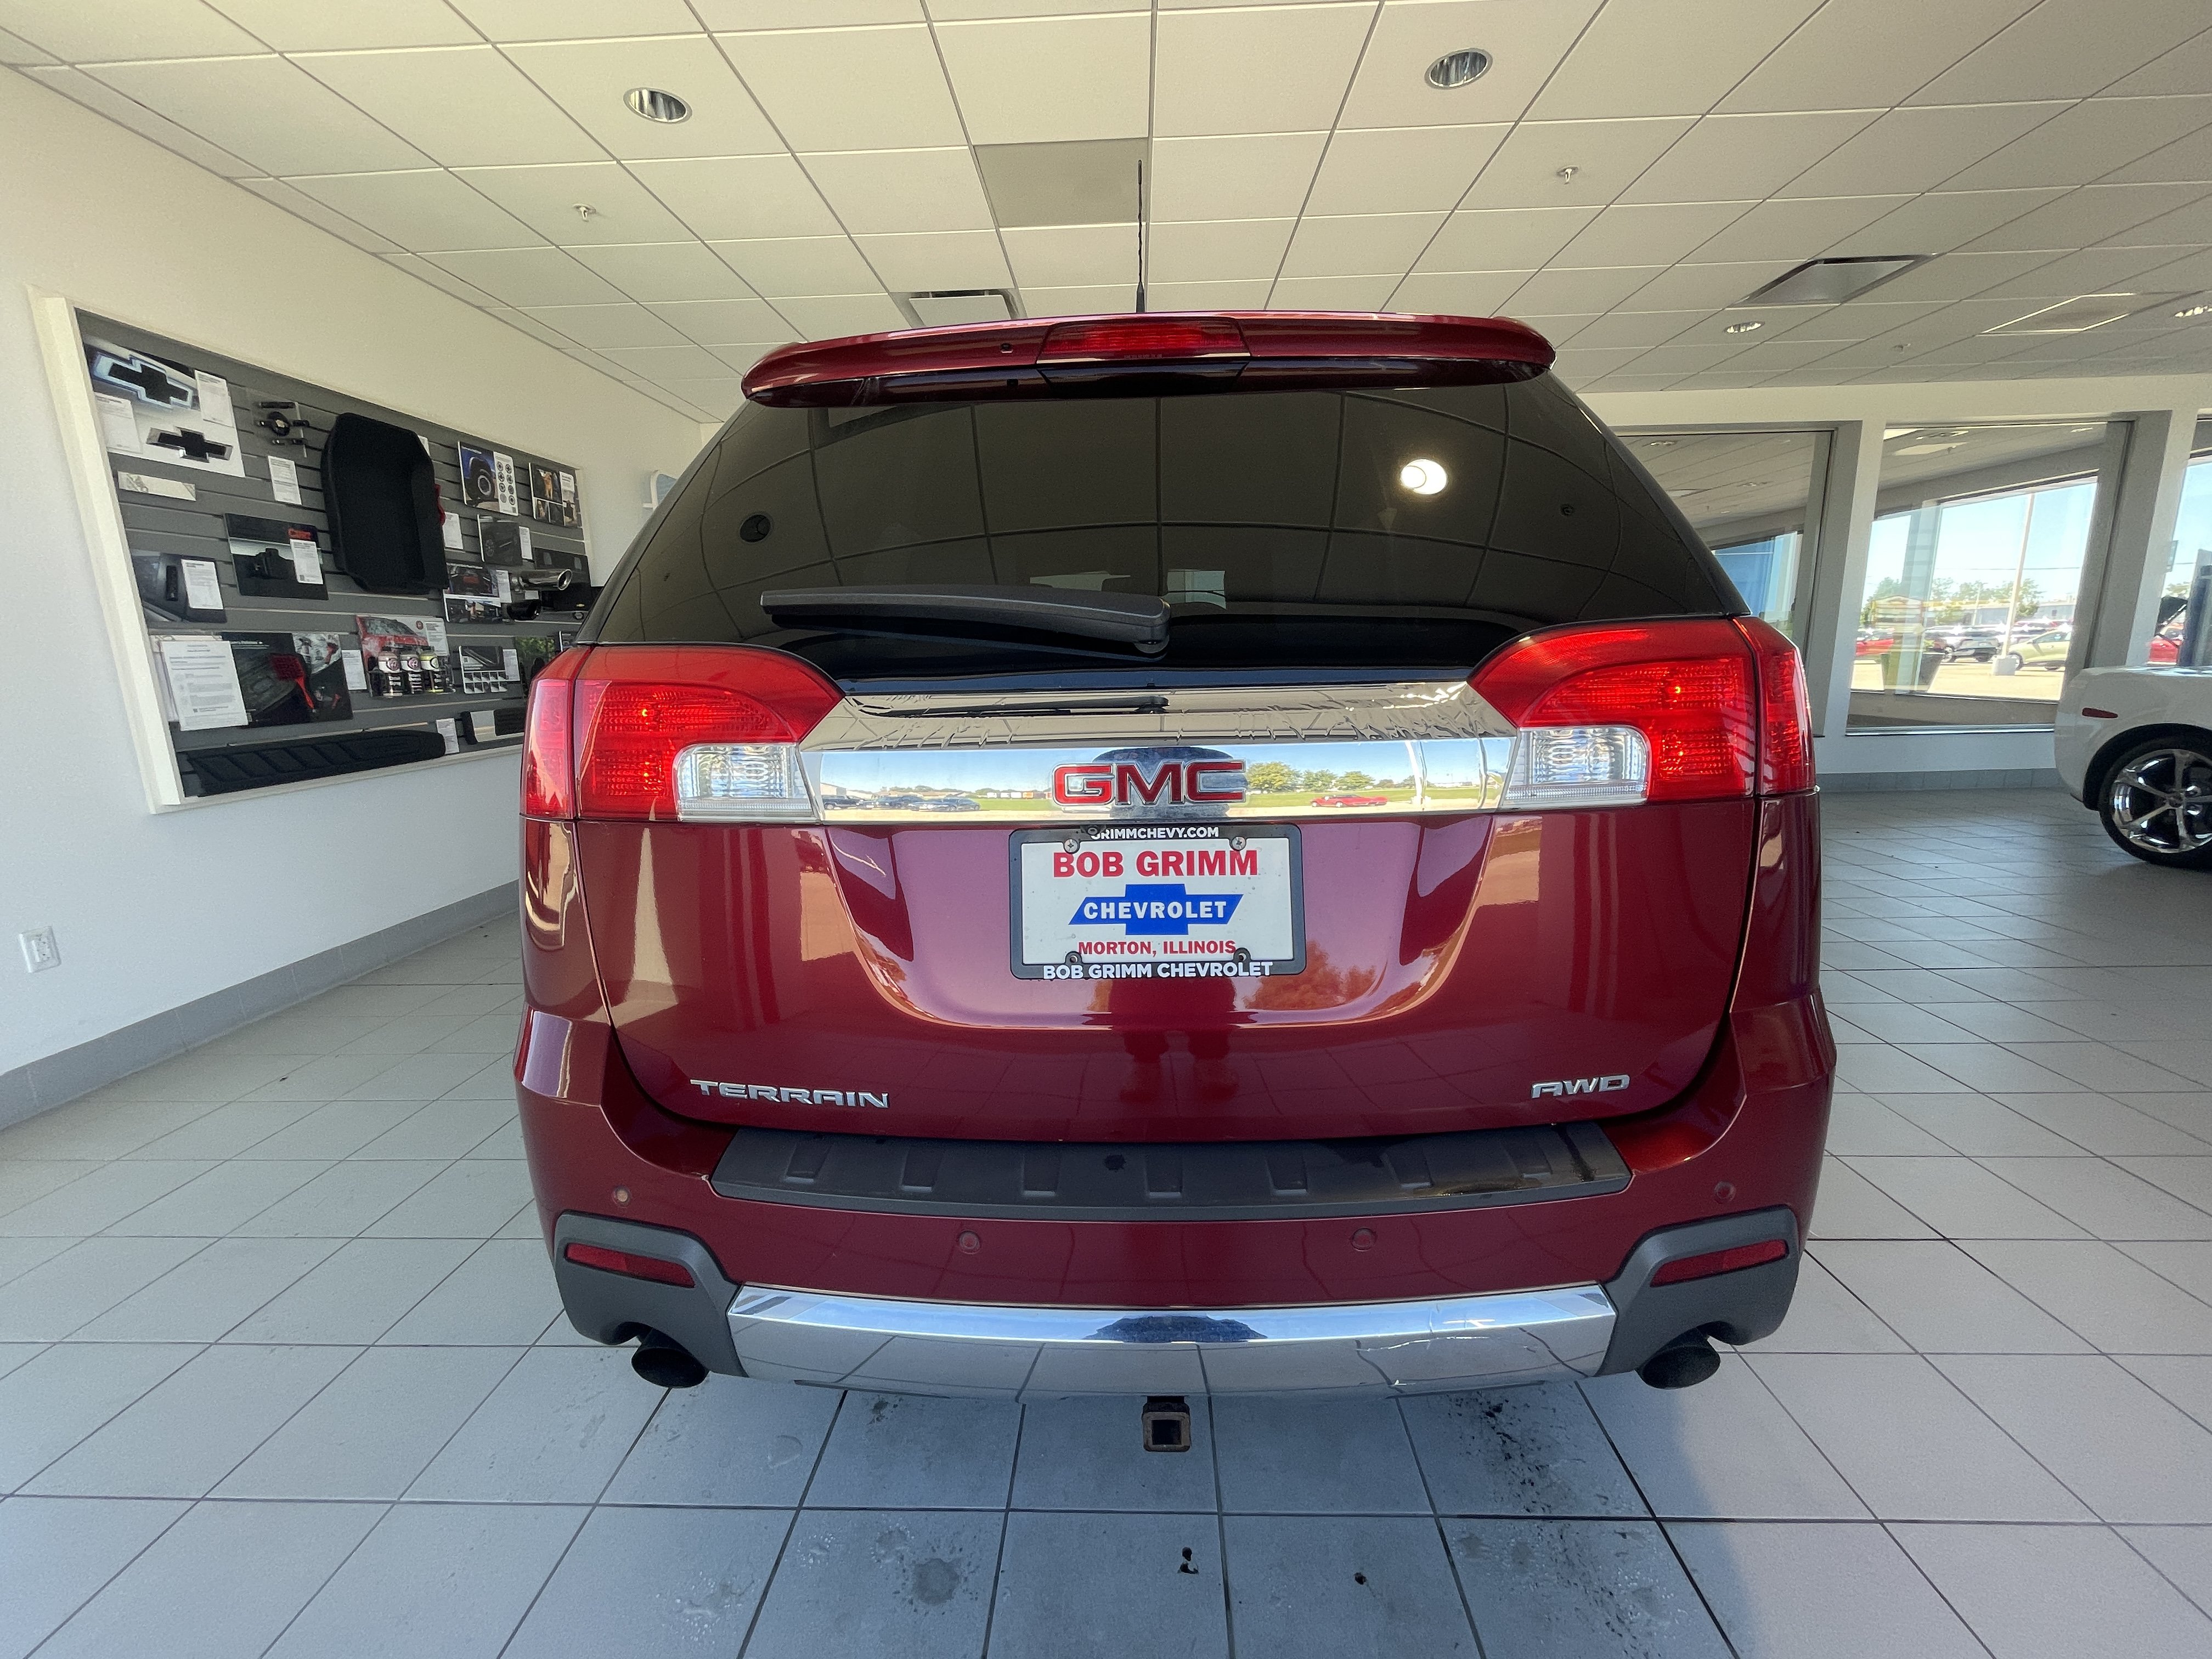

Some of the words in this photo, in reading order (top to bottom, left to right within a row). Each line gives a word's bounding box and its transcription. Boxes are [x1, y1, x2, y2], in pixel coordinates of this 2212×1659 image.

[1053, 760, 1245, 806] GMC
[1053, 851, 1124, 878] BOB
[1136, 850, 1258, 877] GRIMM
[1084, 901, 1227, 919] CHEVROLET
[1078, 941, 1157, 957] MORTON,
[1163, 940, 1236, 954] ILLINOIS
[1043, 965, 1084, 979] BOB
[1088, 963, 1152, 979] GRIMM
[1156, 961, 1273, 977] CHEVROLET
[690, 1079, 889, 1109] TERRAIN
[1531, 1074, 1630, 1098] AWD
